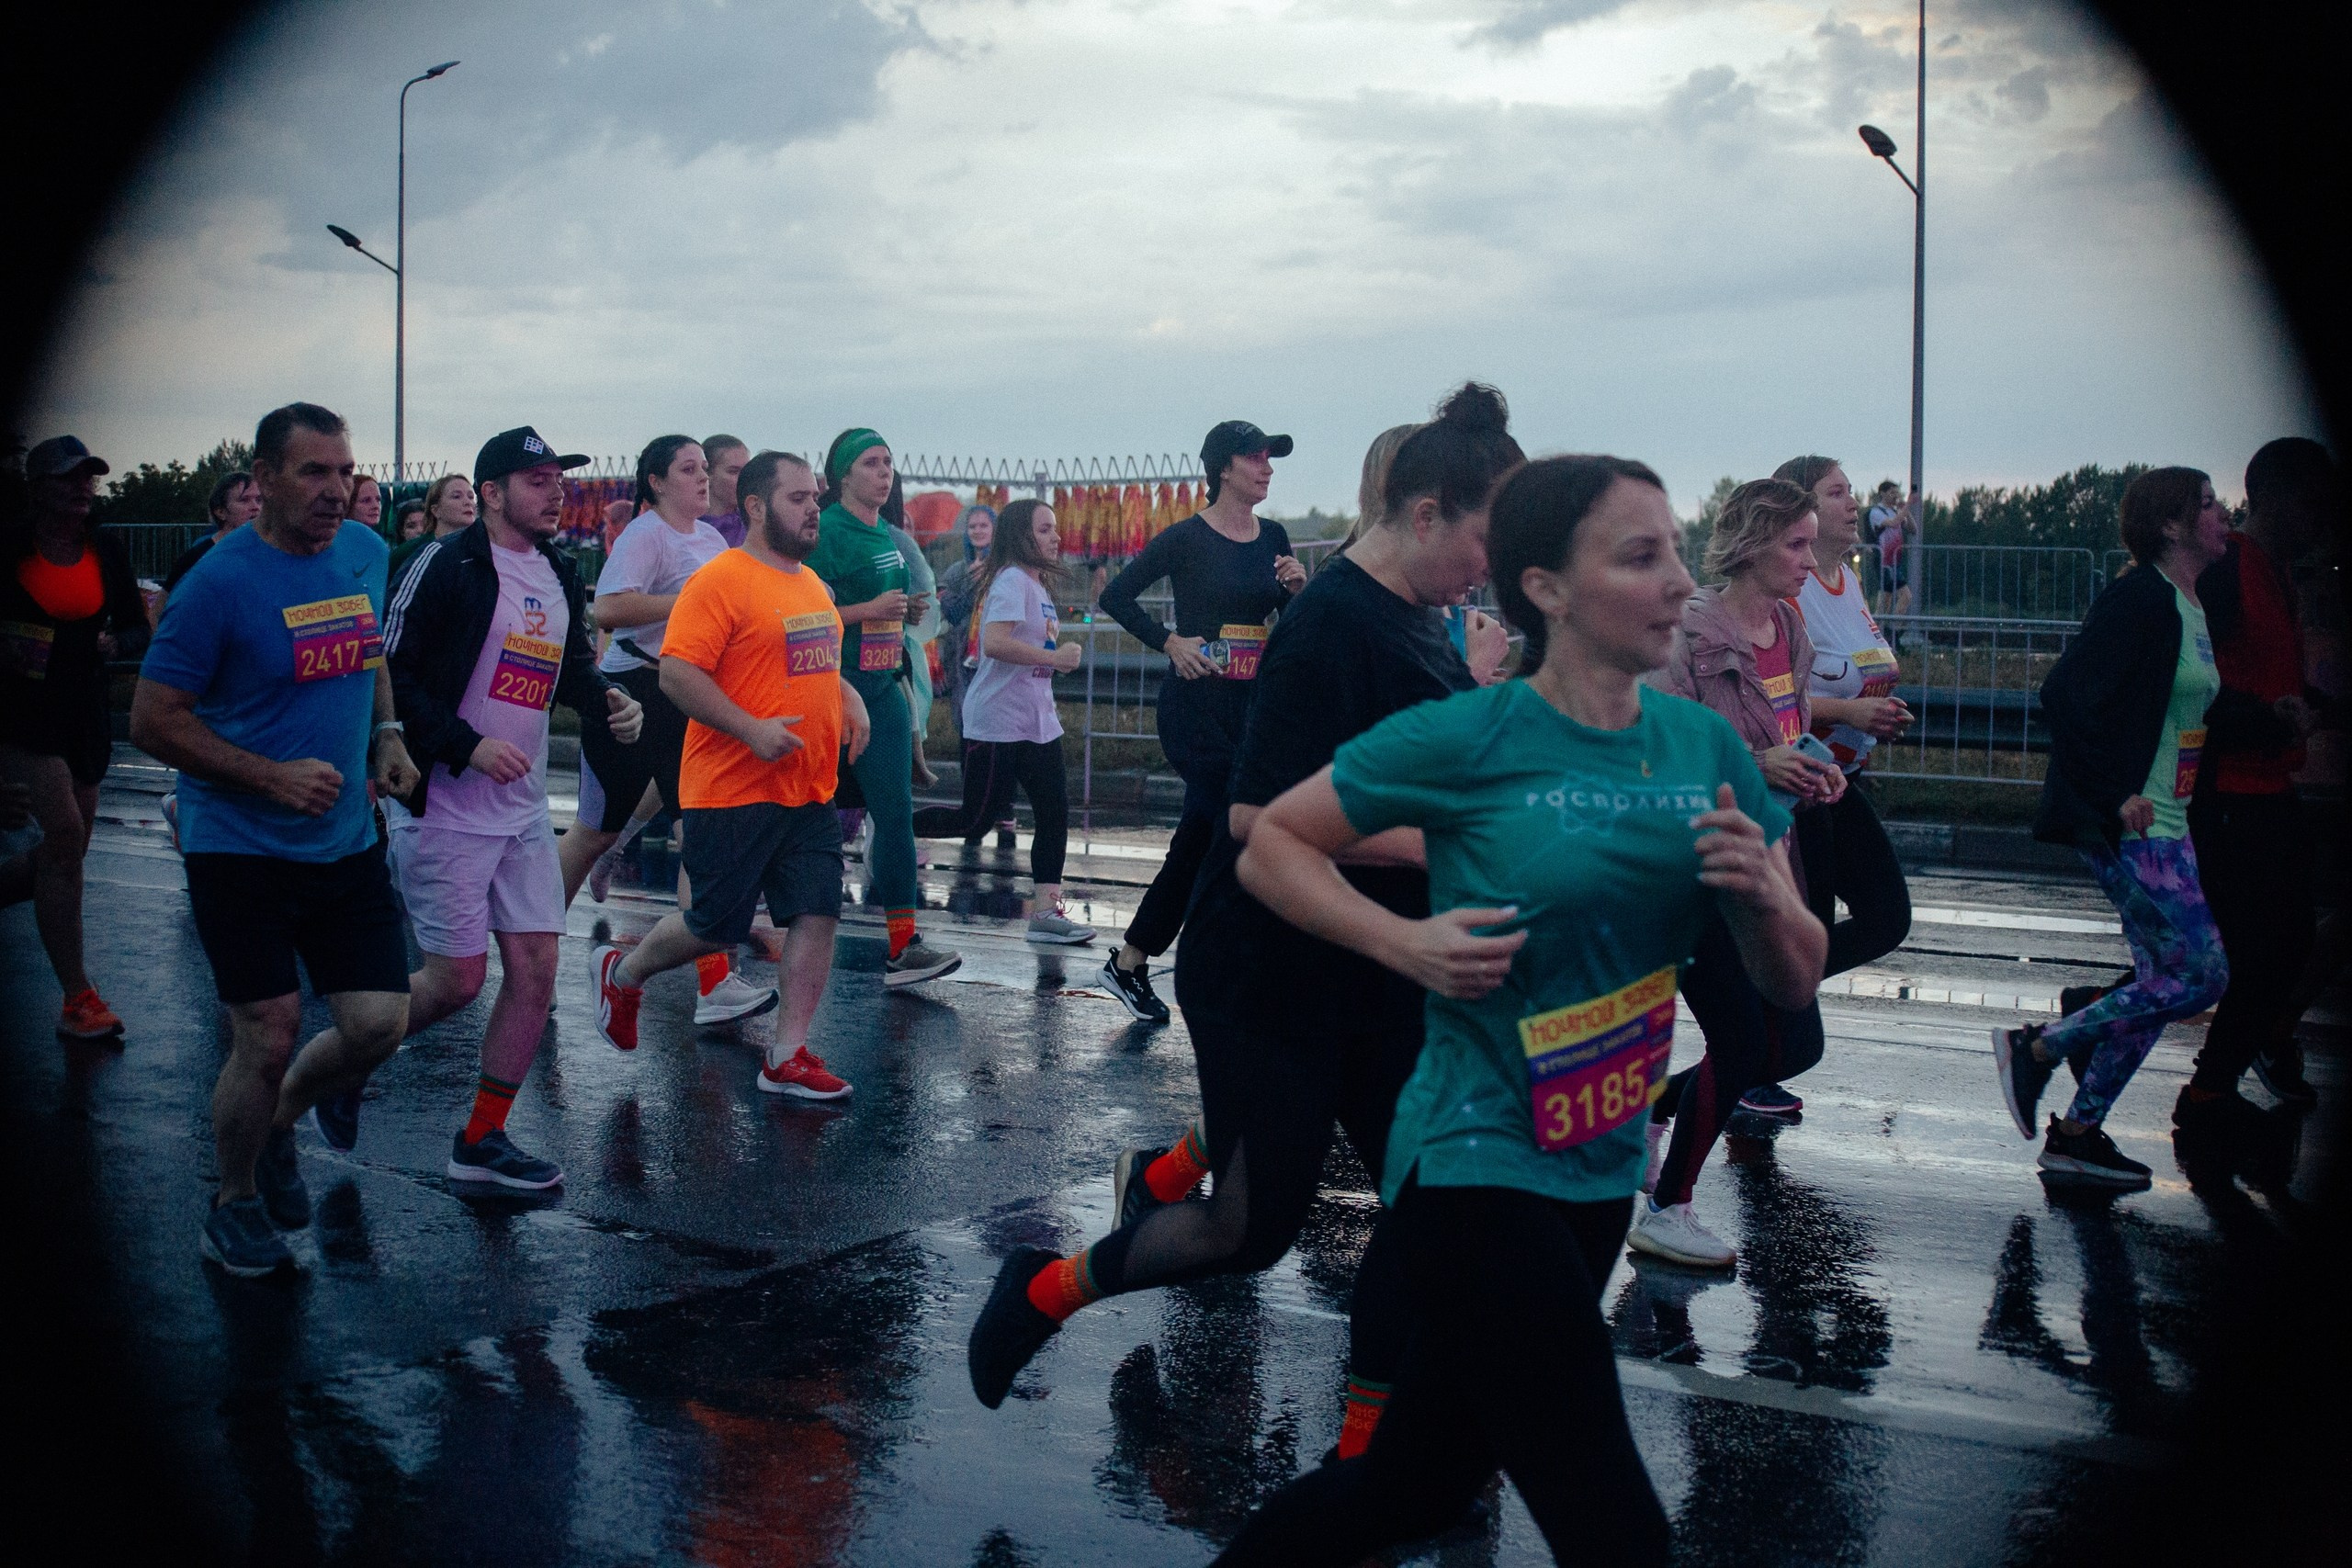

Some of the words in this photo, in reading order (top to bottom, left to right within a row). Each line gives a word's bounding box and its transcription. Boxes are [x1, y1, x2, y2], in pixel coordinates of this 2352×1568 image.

[300, 639, 360, 677] 2417
[507, 637, 549, 656] НОЧНОЙ
[792, 646, 835, 672] 2204
[865, 648, 896, 667] 3281
[496, 671, 548, 705] 2201
[1544, 1057, 1646, 1142] 3185
